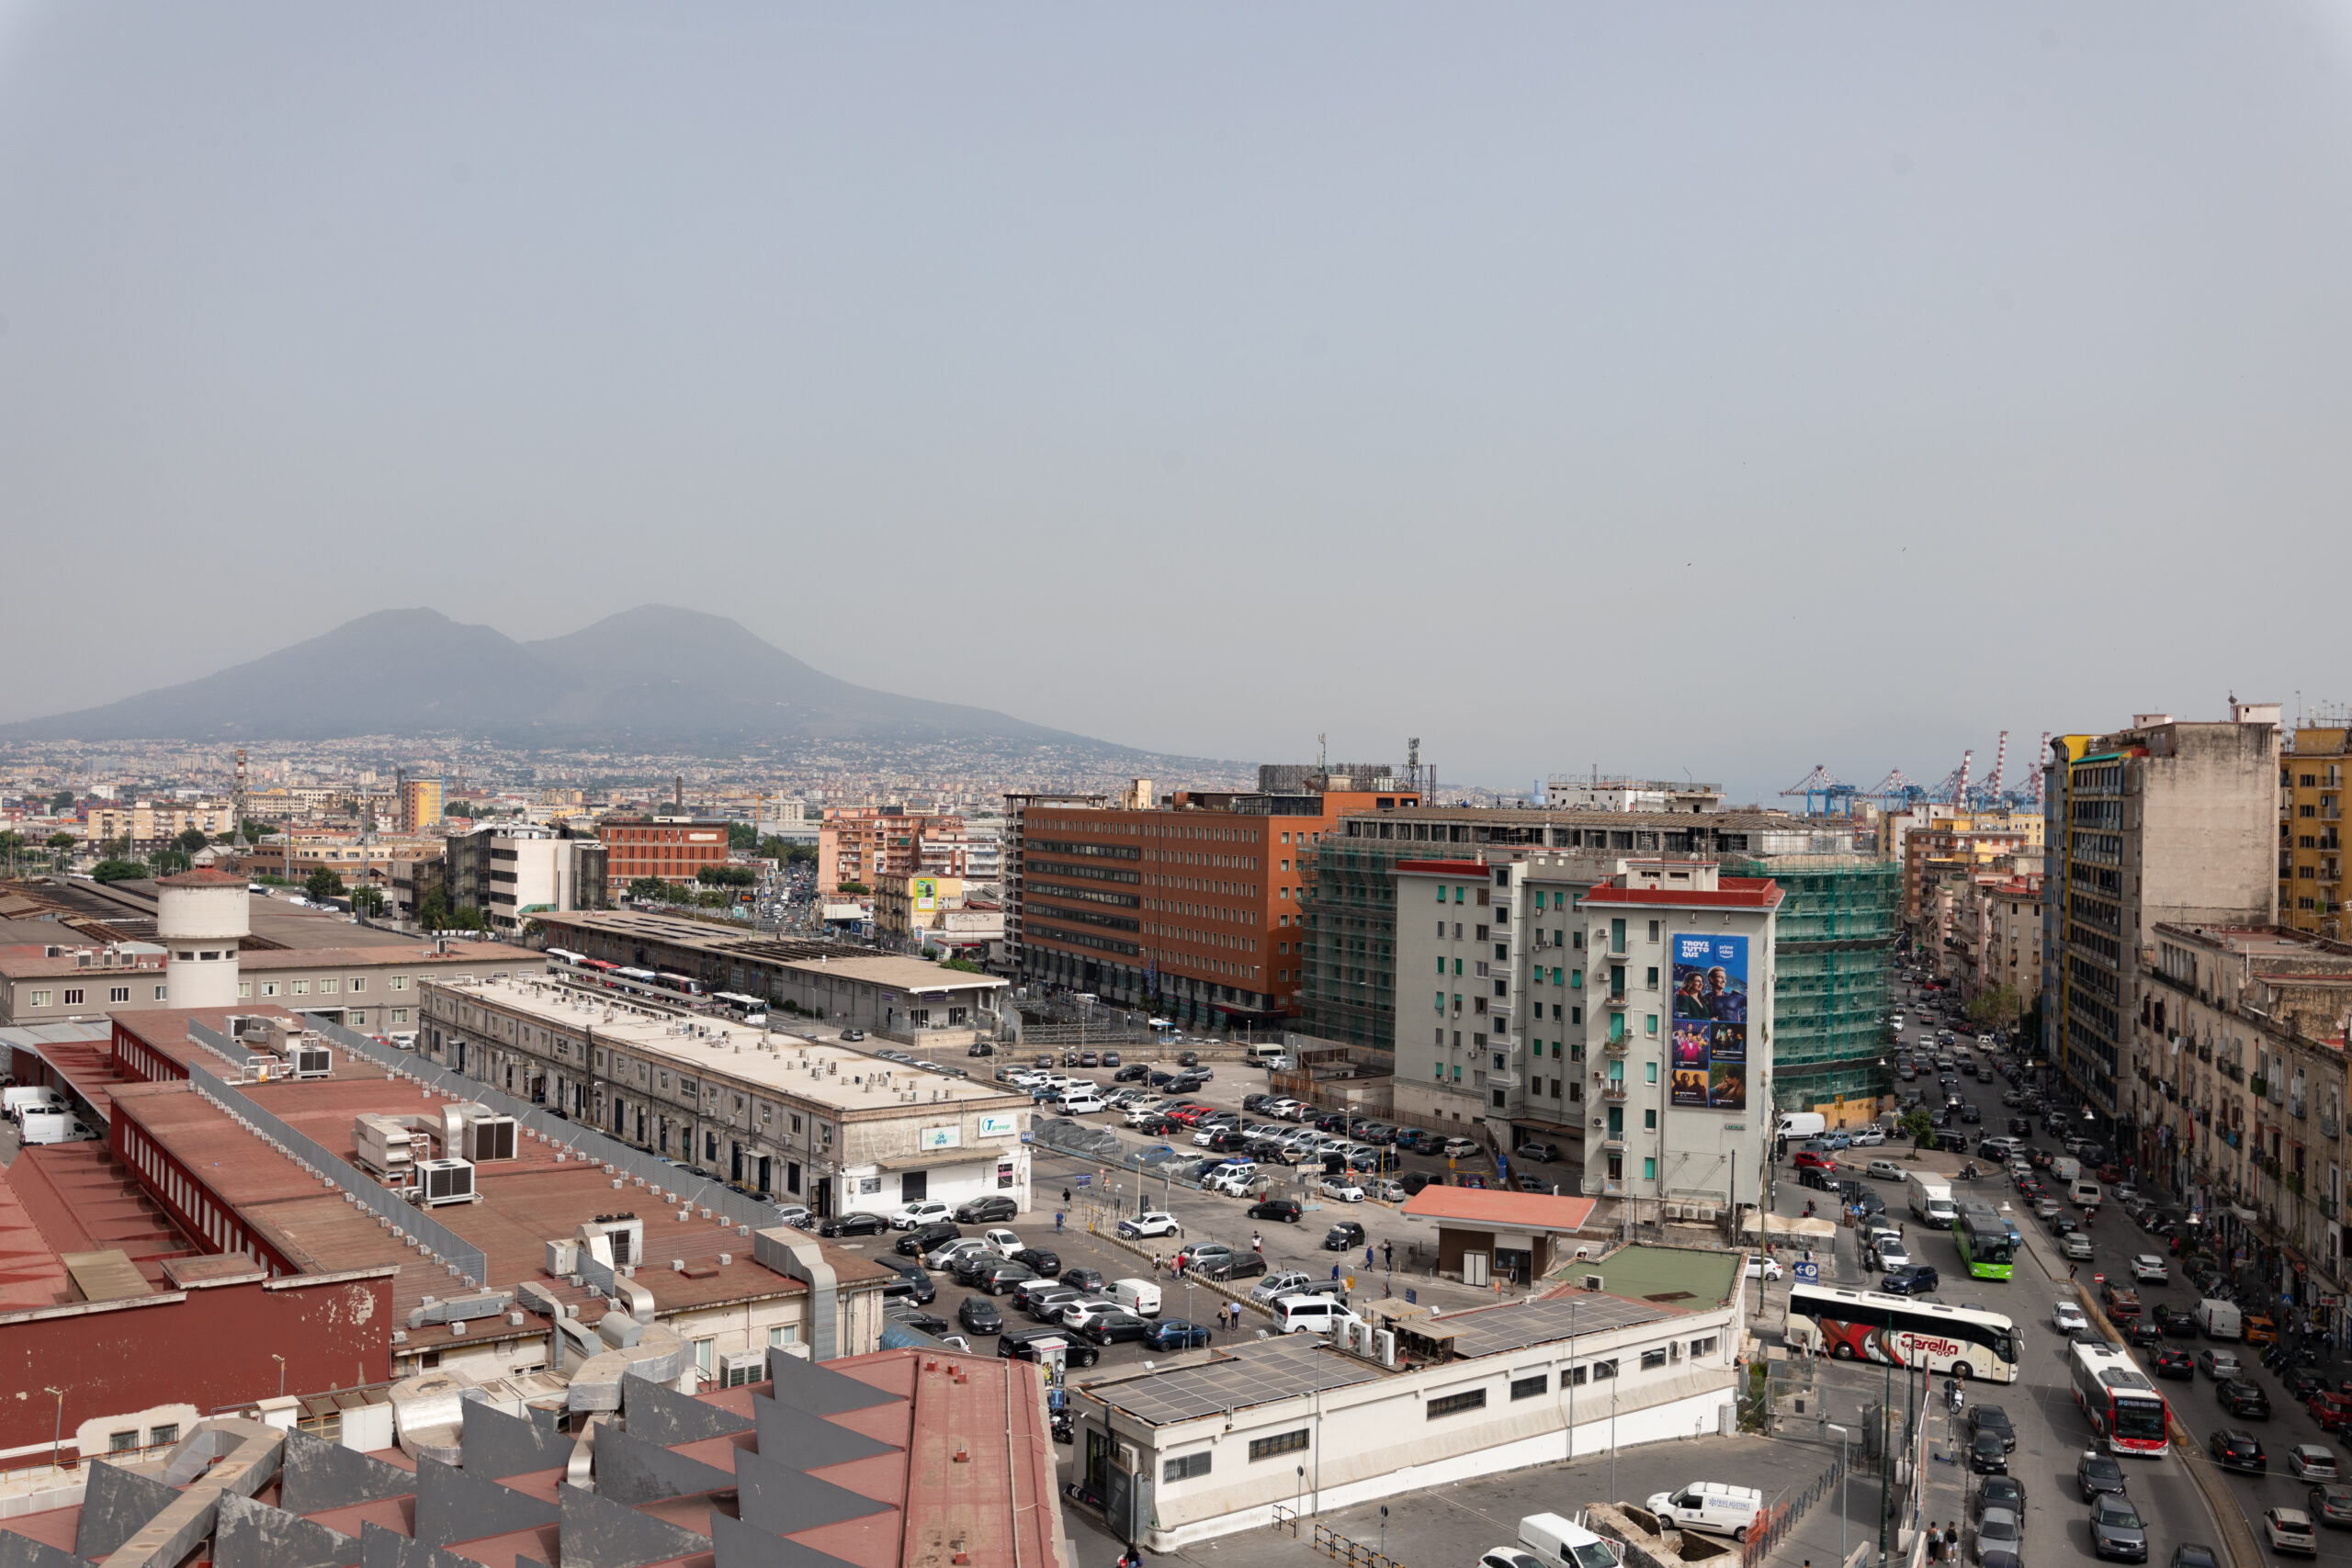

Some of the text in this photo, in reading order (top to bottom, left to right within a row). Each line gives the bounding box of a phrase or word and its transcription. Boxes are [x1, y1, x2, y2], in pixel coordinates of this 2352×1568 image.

[987, 1120, 994, 1130] T
[1901, 1334, 1958, 1357] Cerella
[1052, 1390, 1062, 1404] T
